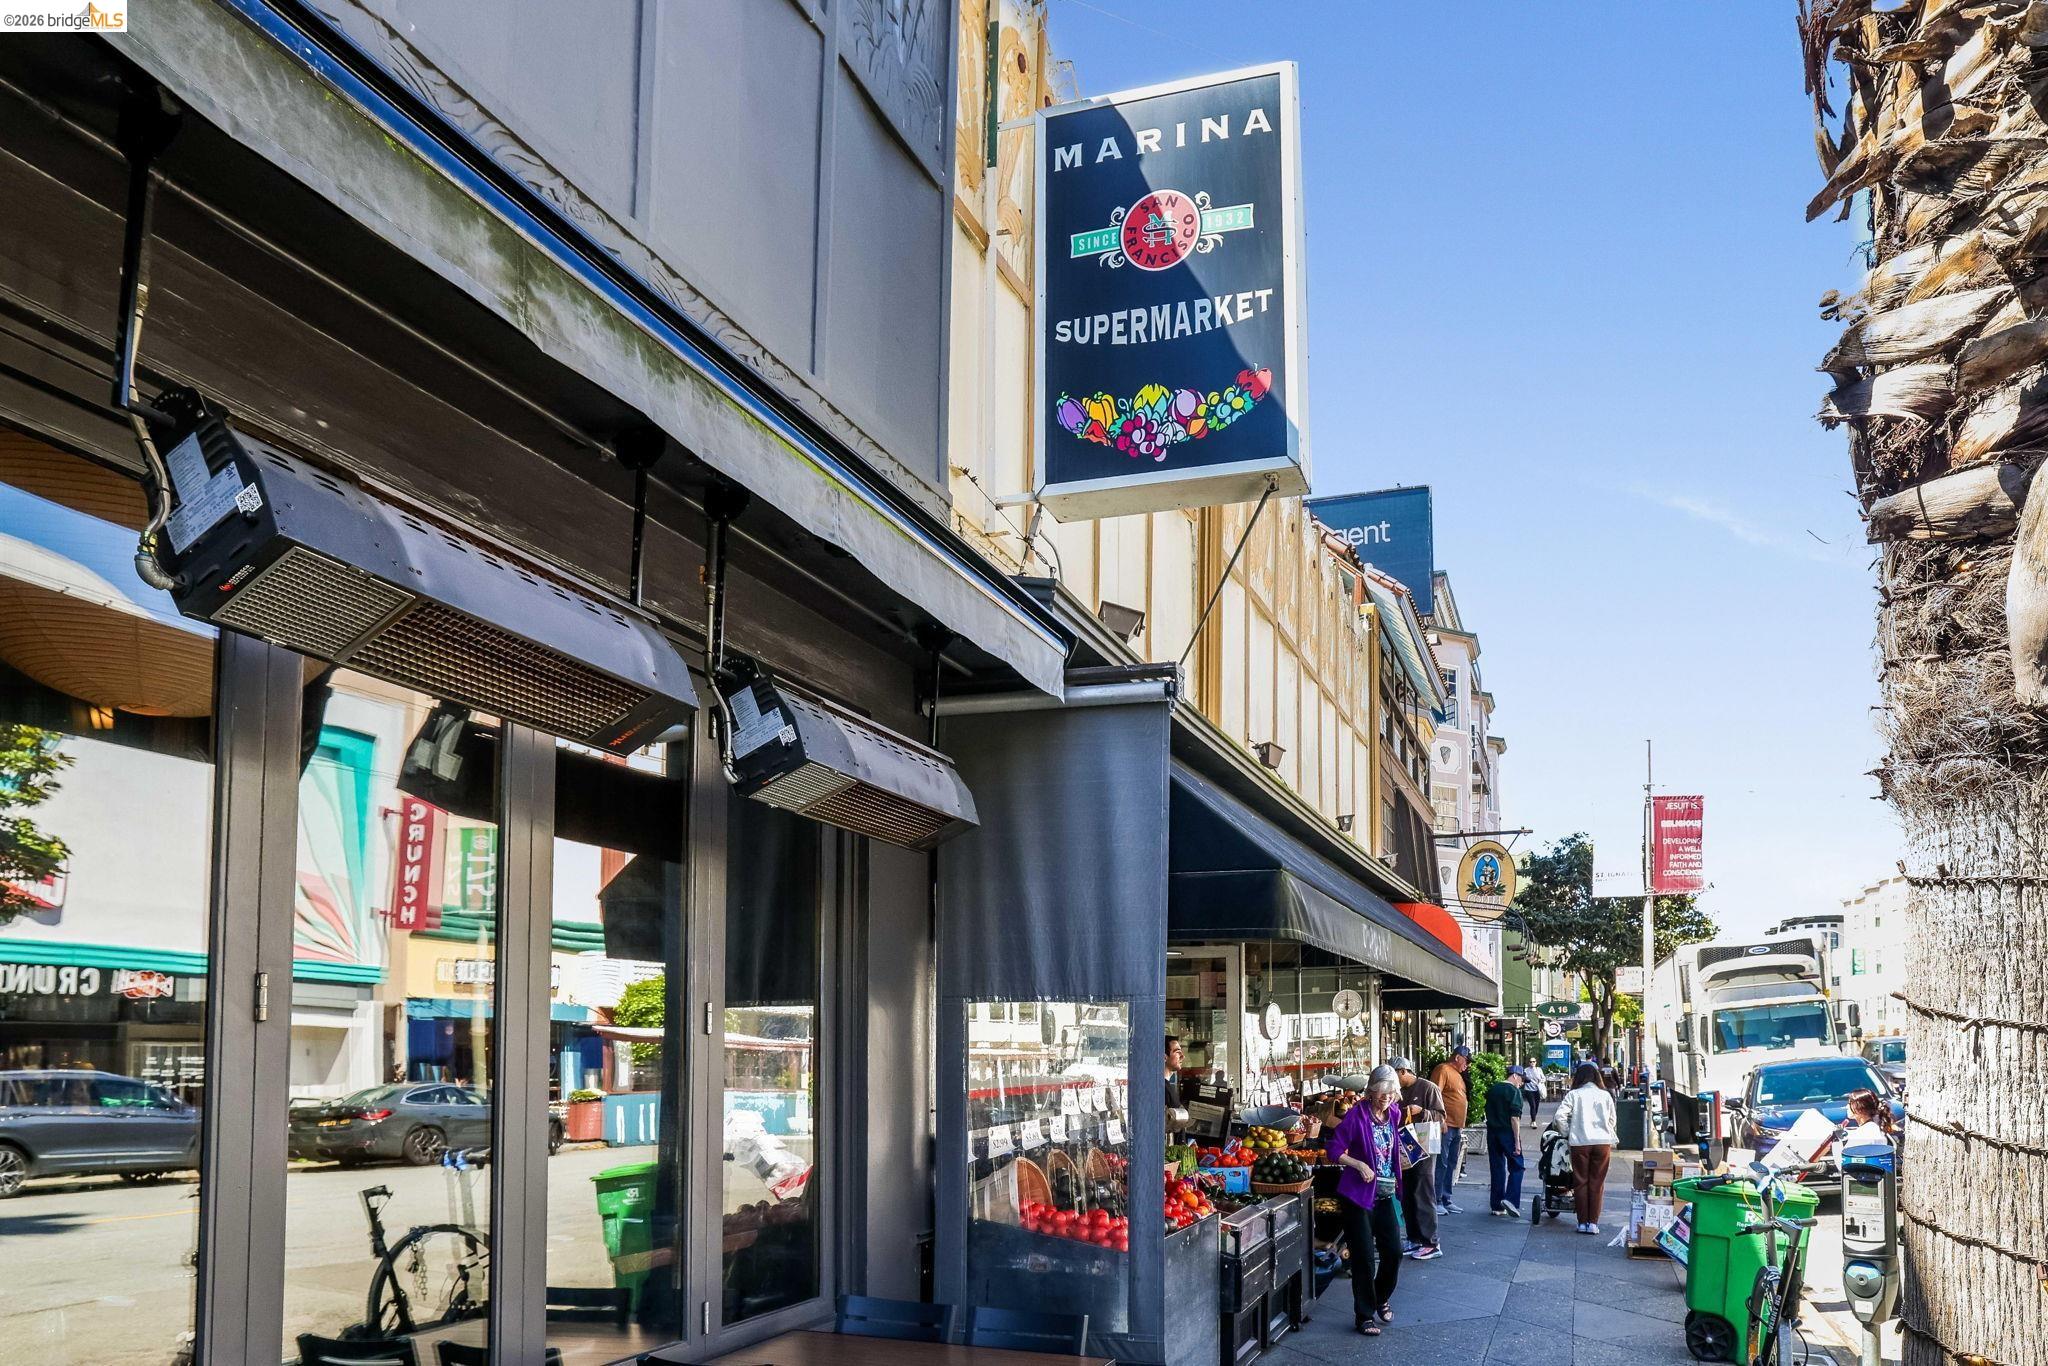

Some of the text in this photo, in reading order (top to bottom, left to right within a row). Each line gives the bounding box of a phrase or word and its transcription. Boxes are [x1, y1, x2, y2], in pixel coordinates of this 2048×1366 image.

[1054, 108, 1272, 172] MARINA
[1140, 195, 1178, 213] SAN
[1078, 211, 1244, 251] SINCE 1932
[1126, 213, 1194, 265] FRANCISCO
[1055, 288, 1273, 346] SUPERMARKET
[1665, 802, 1689, 810] JESUIT
[1662, 837, 1702, 845] DEVELOPING
[1669, 861, 1687, 869] FAITH
[1662, 869, 1703, 877] CONSCIENCE
[1548, 1006, 1556, 1014] A
